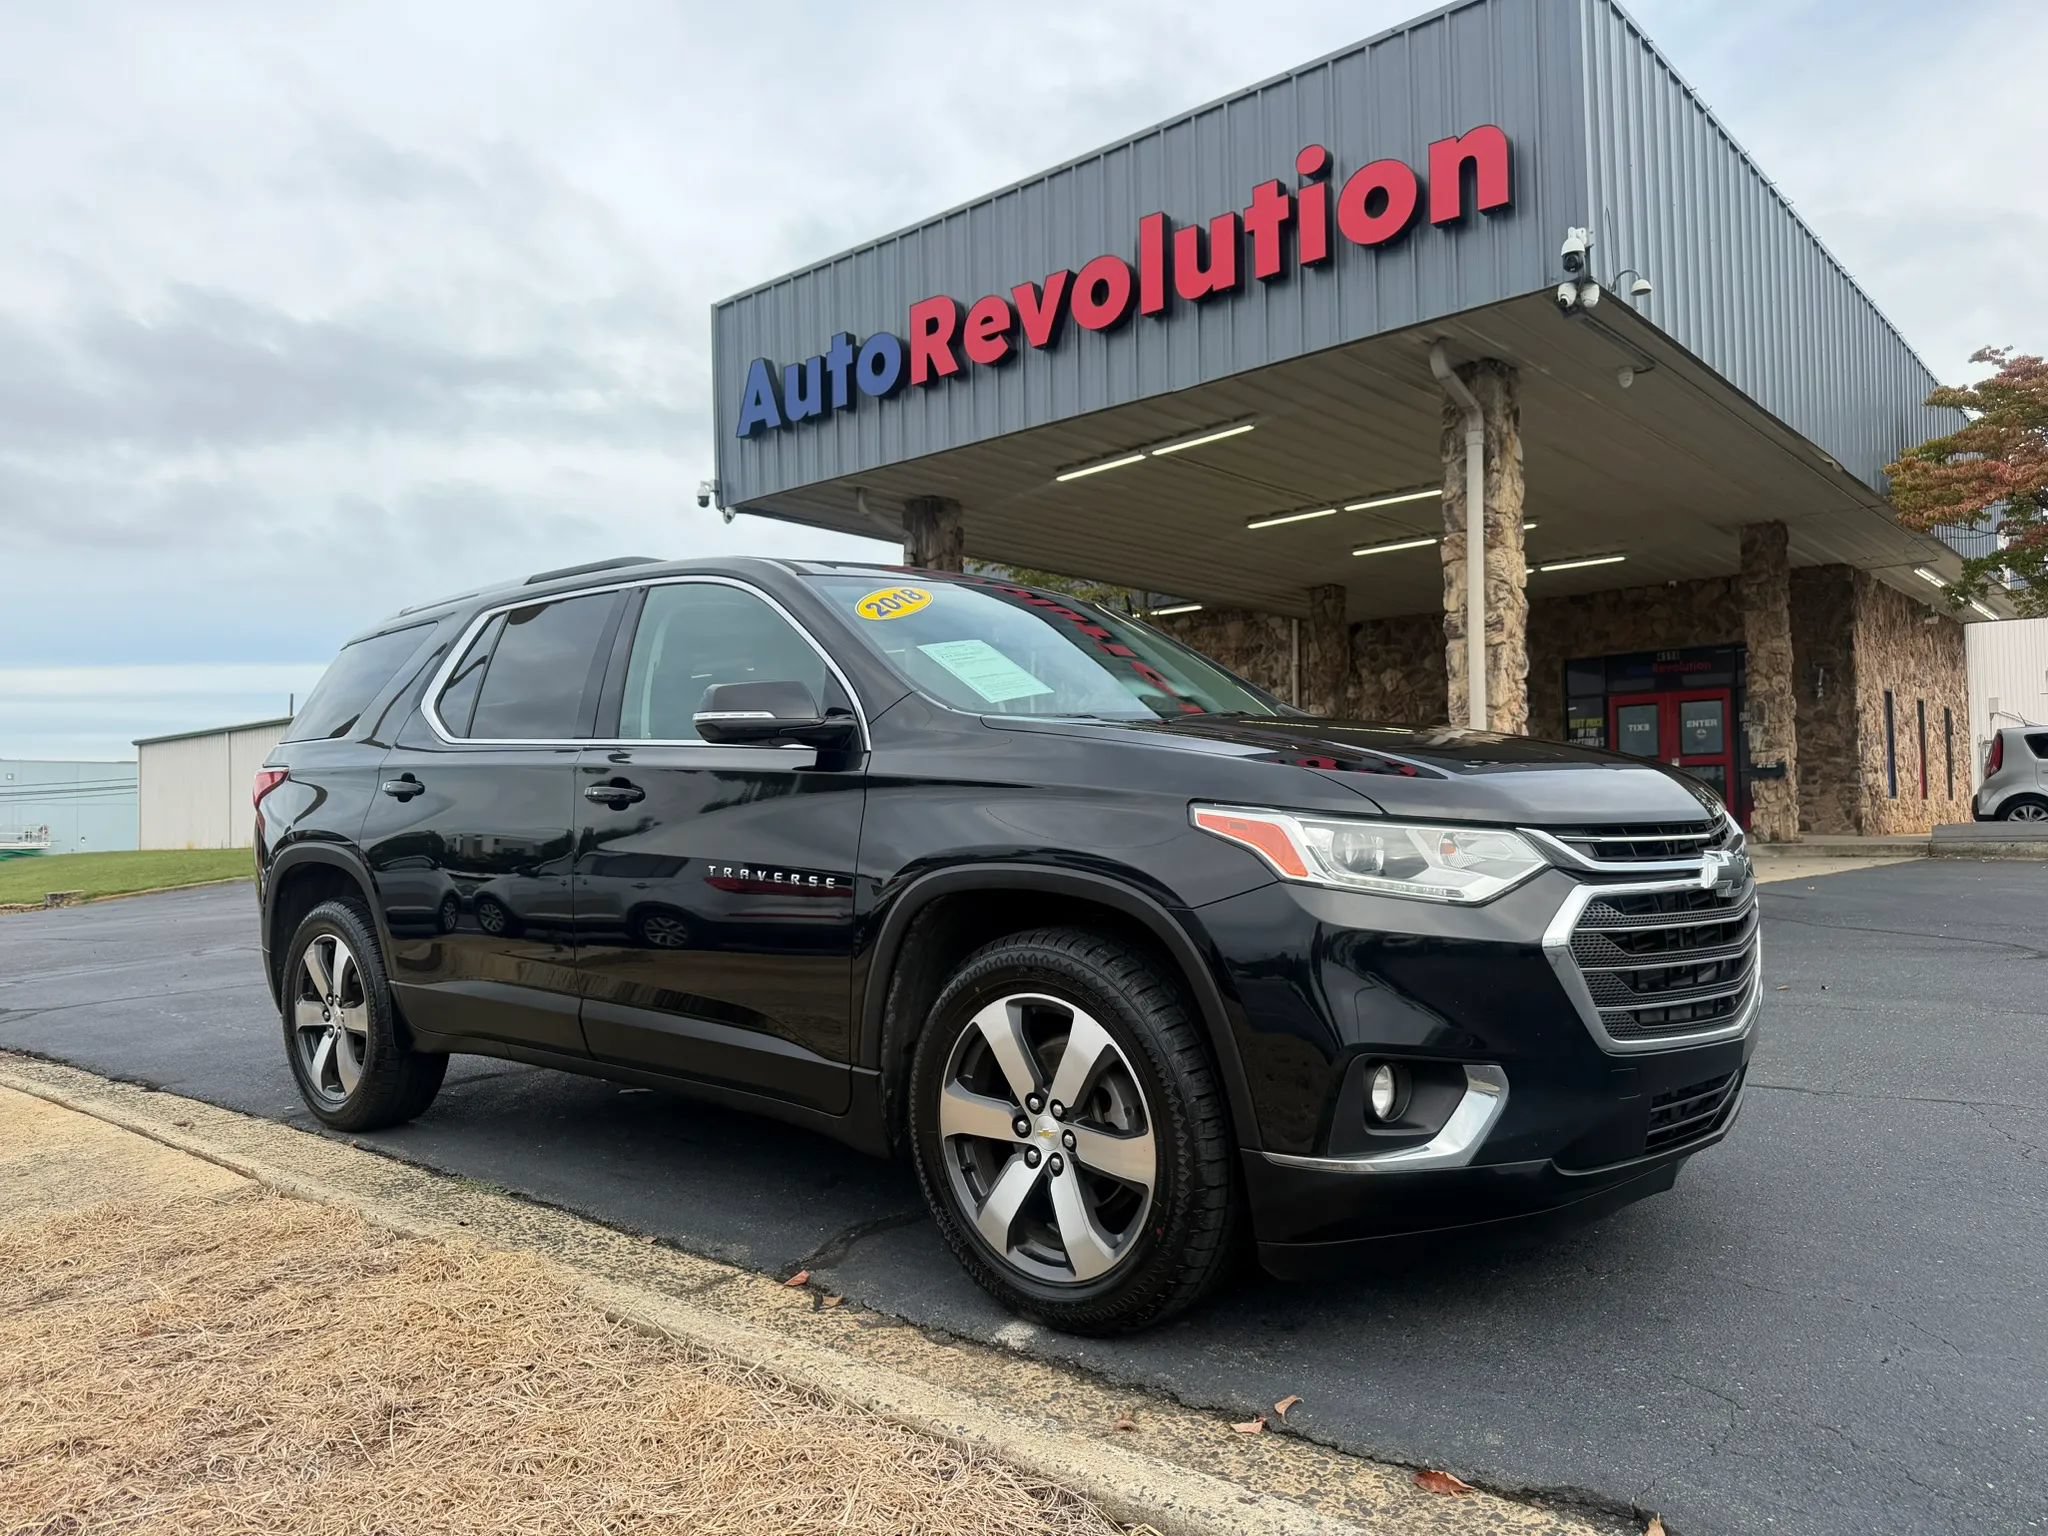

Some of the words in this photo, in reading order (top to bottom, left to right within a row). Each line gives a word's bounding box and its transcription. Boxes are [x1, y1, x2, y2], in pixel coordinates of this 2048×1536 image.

[865, 588, 924, 617] 2018
[1686, 718, 1718, 729] ENTER
[708, 865, 836, 889] TRAVERSE
